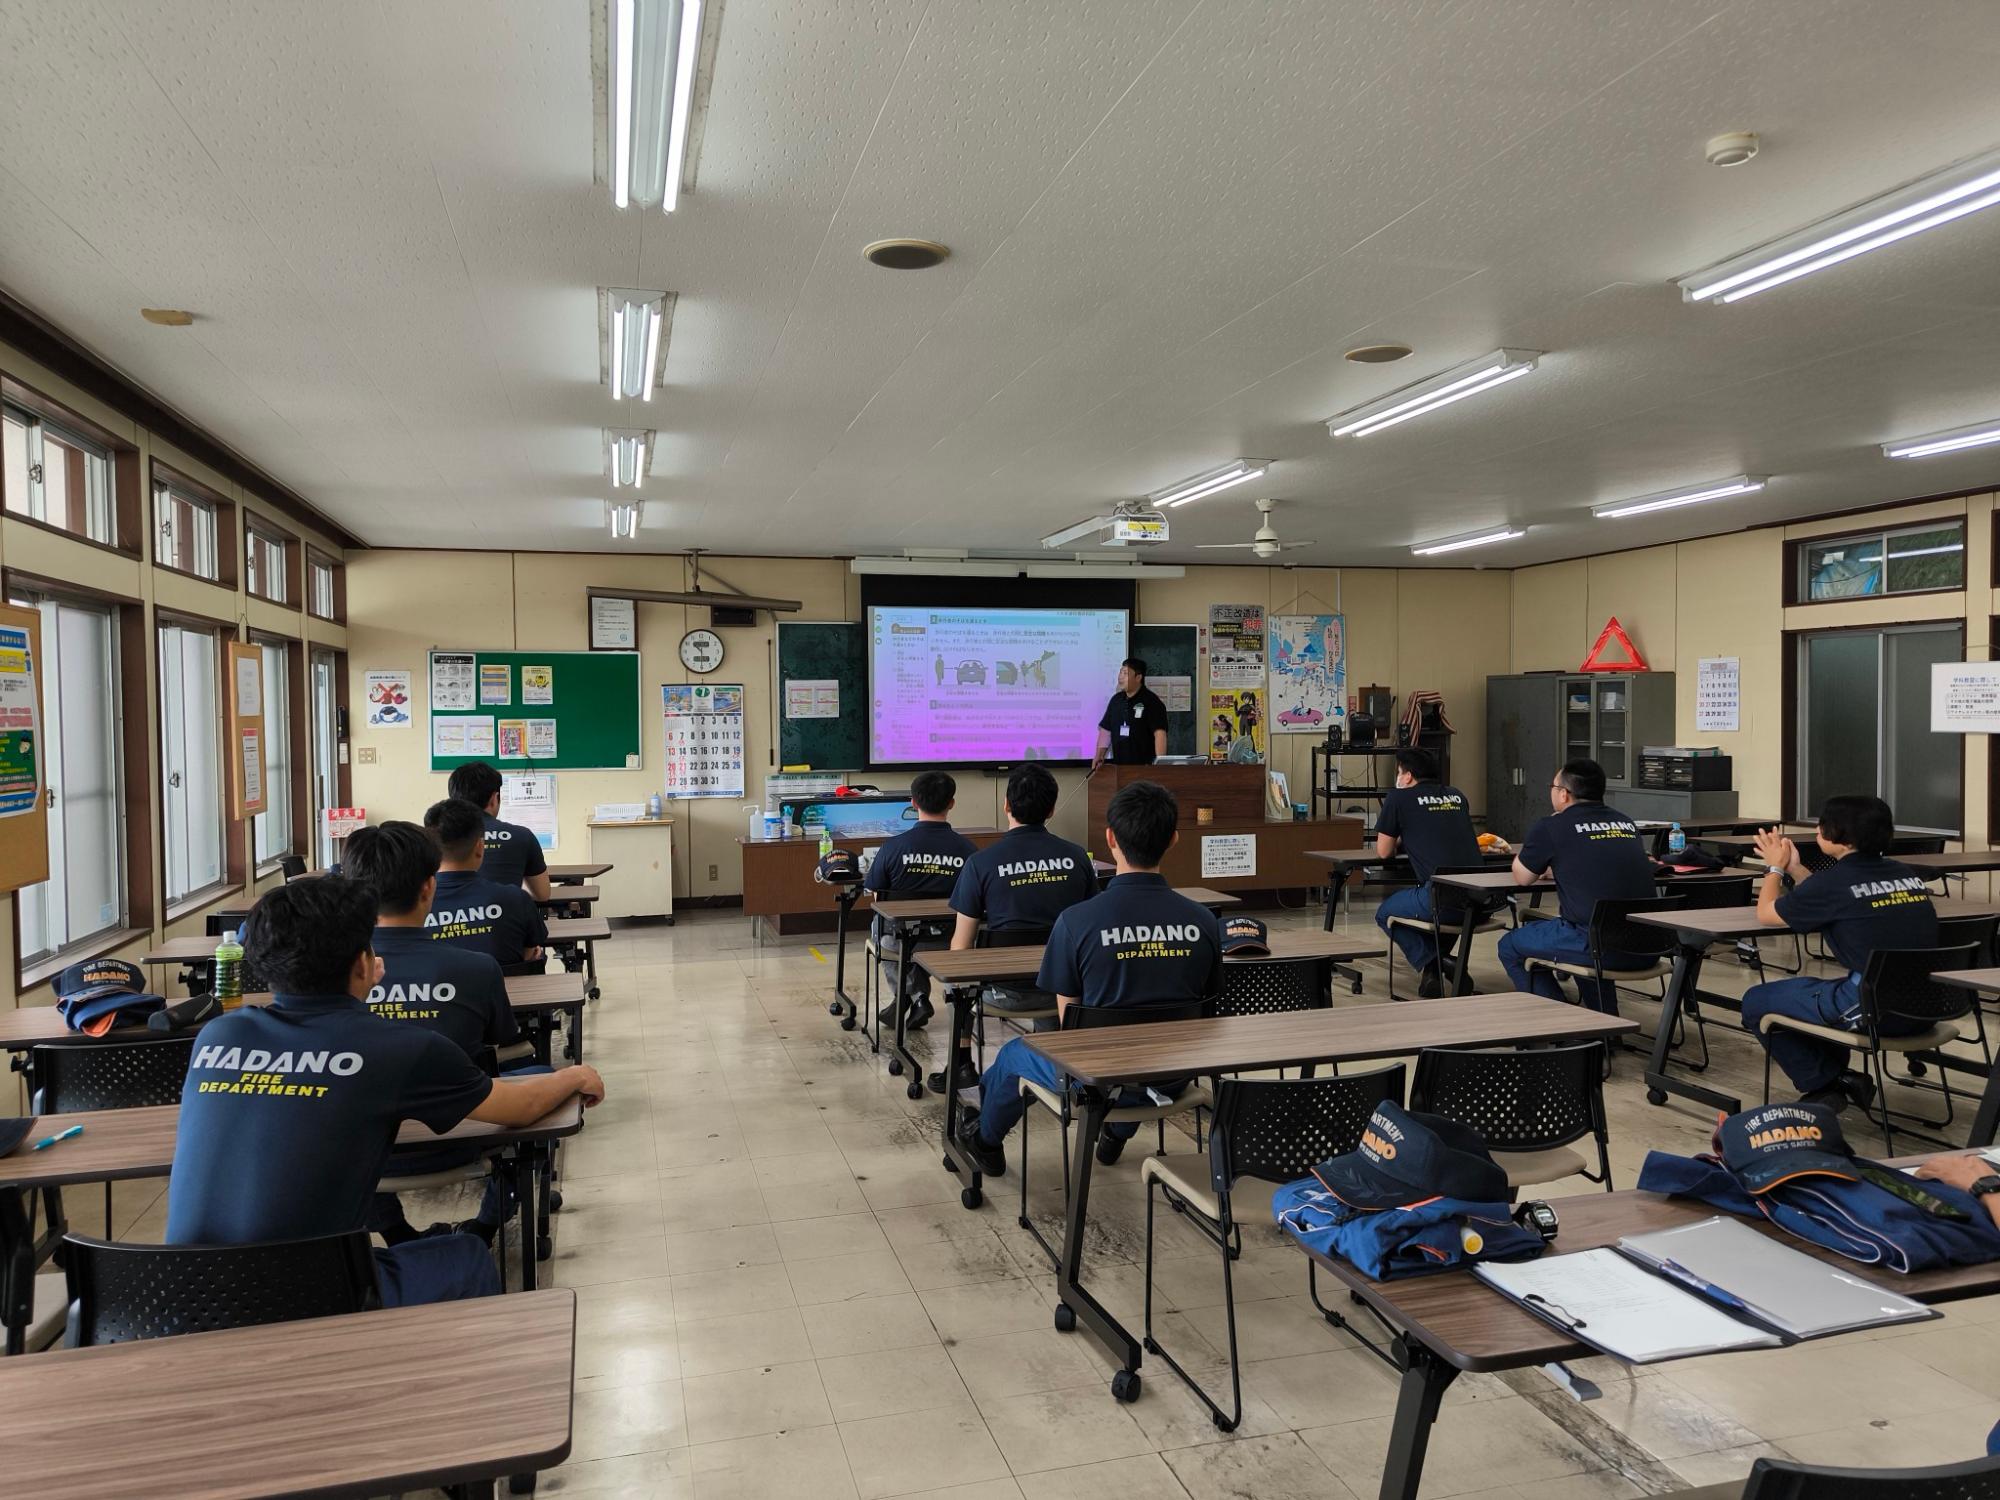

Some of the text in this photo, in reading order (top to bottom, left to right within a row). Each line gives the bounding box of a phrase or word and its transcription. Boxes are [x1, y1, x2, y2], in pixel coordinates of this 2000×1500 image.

[690, 716, 738, 725] 1 2 3 4 5
[668, 731, 740, 741] 6 7 8 9 10 11 12
[668, 746, 740, 756] 13 14 15 16 17 18 19
[690, 762, 698, 770] 22
[700, 761, 708, 770] 23
[711, 761, 718, 770] 24
[722, 761, 730, 770] 25
[732, 761, 740, 769] 26
[668, 776, 719, 786] 27 28 29 30 31
[1574, 821, 1635, 833] HADANO
[902, 853, 964, 868] HADANO
[907, 867, 955, 876] DEPARTMENT
[998, 857, 1075, 878] HADANO
[1010, 875, 1069, 886] DEPARTMENT
[1850, 877, 1926, 899] HADANO
[1890, 891, 1909, 899] FIRE
[424, 904, 503, 928] ADANO
[432, 926, 493, 940] PARTMENT
[443, 923, 467, 932] FIRE
[1100, 924, 1200, 947] HADANO
[1141, 942, 1165, 951] FIRE
[1117, 949, 1192, 960] DEPARTMENT
[83, 971, 131, 983] HADANO
[366, 982, 457, 1003] DANO
[370, 1003, 404, 1013] FIRE
[193, 1045, 364, 1077] HADANO
[240, 1073, 284, 1084] FIRE
[198, 1082, 328, 1098] DEPARTMENT
[1745, 1107, 1817, 1134] FIRE DEPARTMENT
[1749, 1125, 1823, 1149] HADANO
